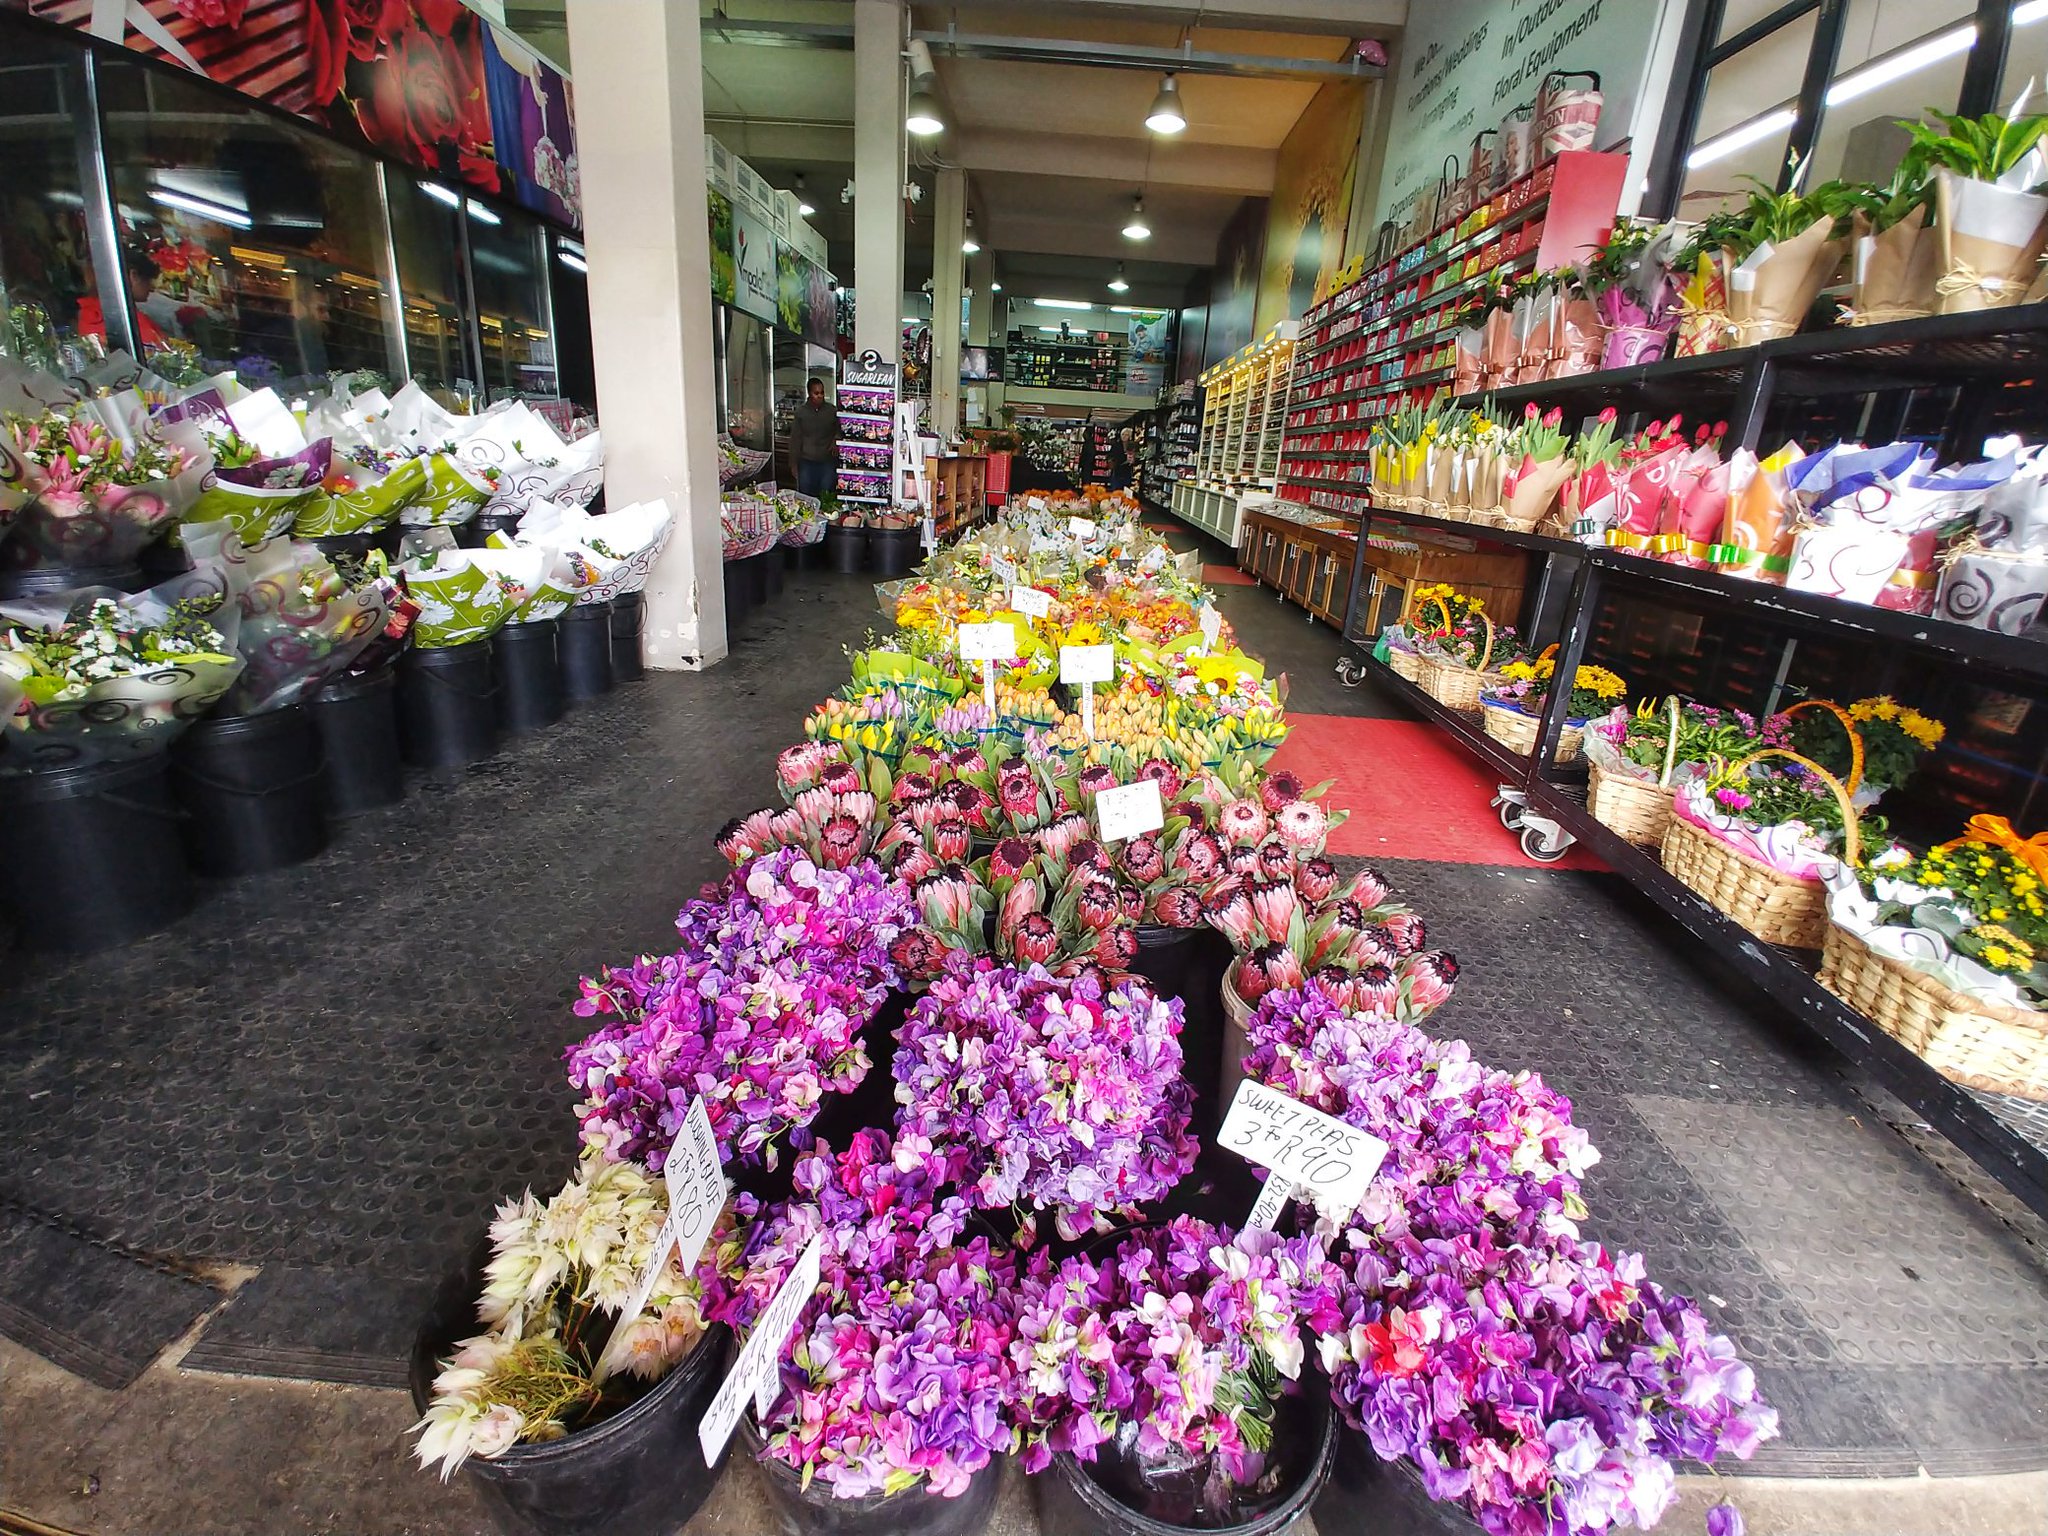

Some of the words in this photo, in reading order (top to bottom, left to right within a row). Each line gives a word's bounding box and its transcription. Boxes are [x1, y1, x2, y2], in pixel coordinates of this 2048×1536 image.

[1492, 56, 1527, 107] Floral
[1525, 1, 1601, 79] Equipment
[846, 370, 896, 386] SUGARLEAN
[1234, 1120, 1262, 1146] 3
[1273, 1134, 1352, 1184] R90
[1238, 1089, 1301, 1126] SWEET
[1299, 1116, 1361, 1156] PEAS
[669, 1147, 687, 1175] 2
[675, 1167, 702, 1239] R80
